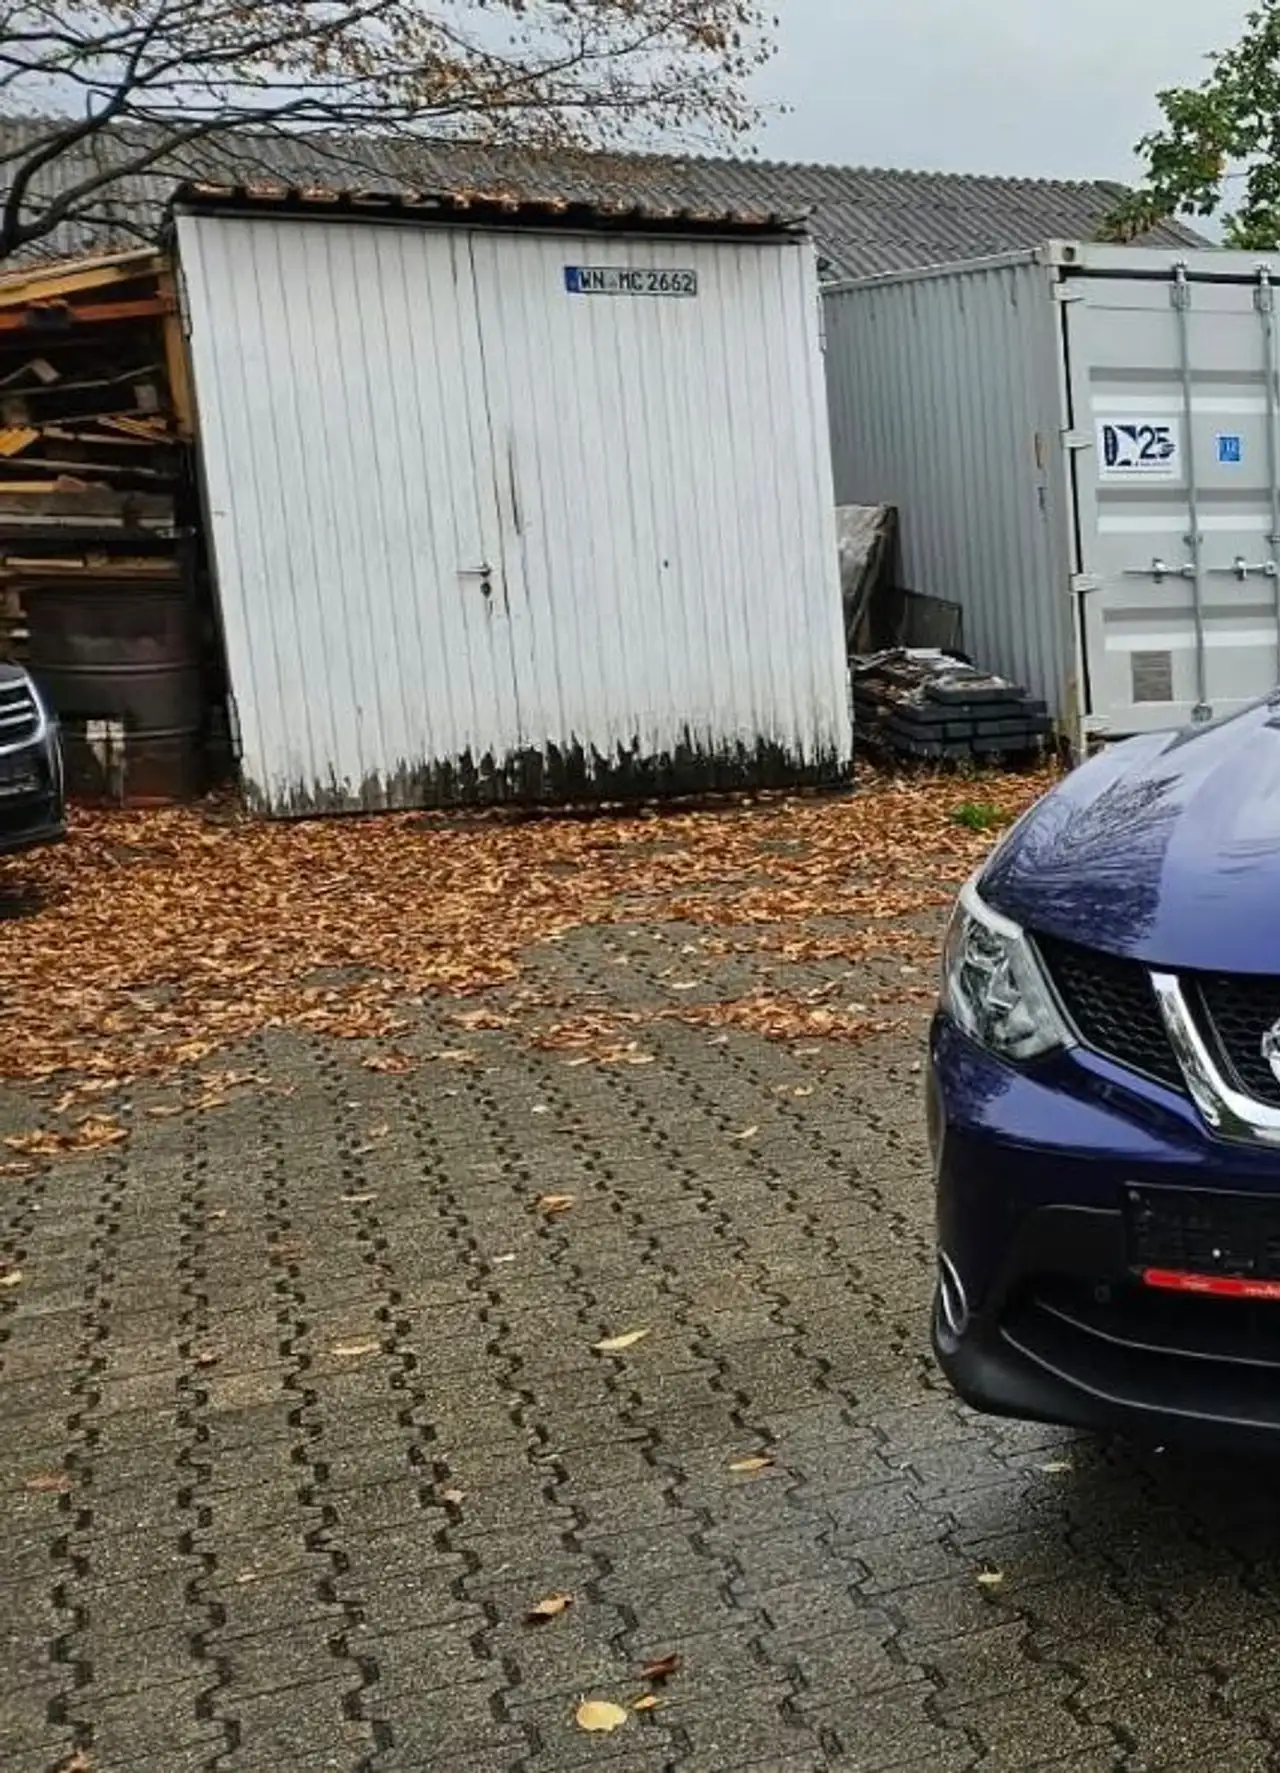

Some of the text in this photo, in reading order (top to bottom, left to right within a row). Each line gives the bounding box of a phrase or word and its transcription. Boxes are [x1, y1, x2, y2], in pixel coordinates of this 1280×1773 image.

[580, 272, 694, 292] WN MC 2662
